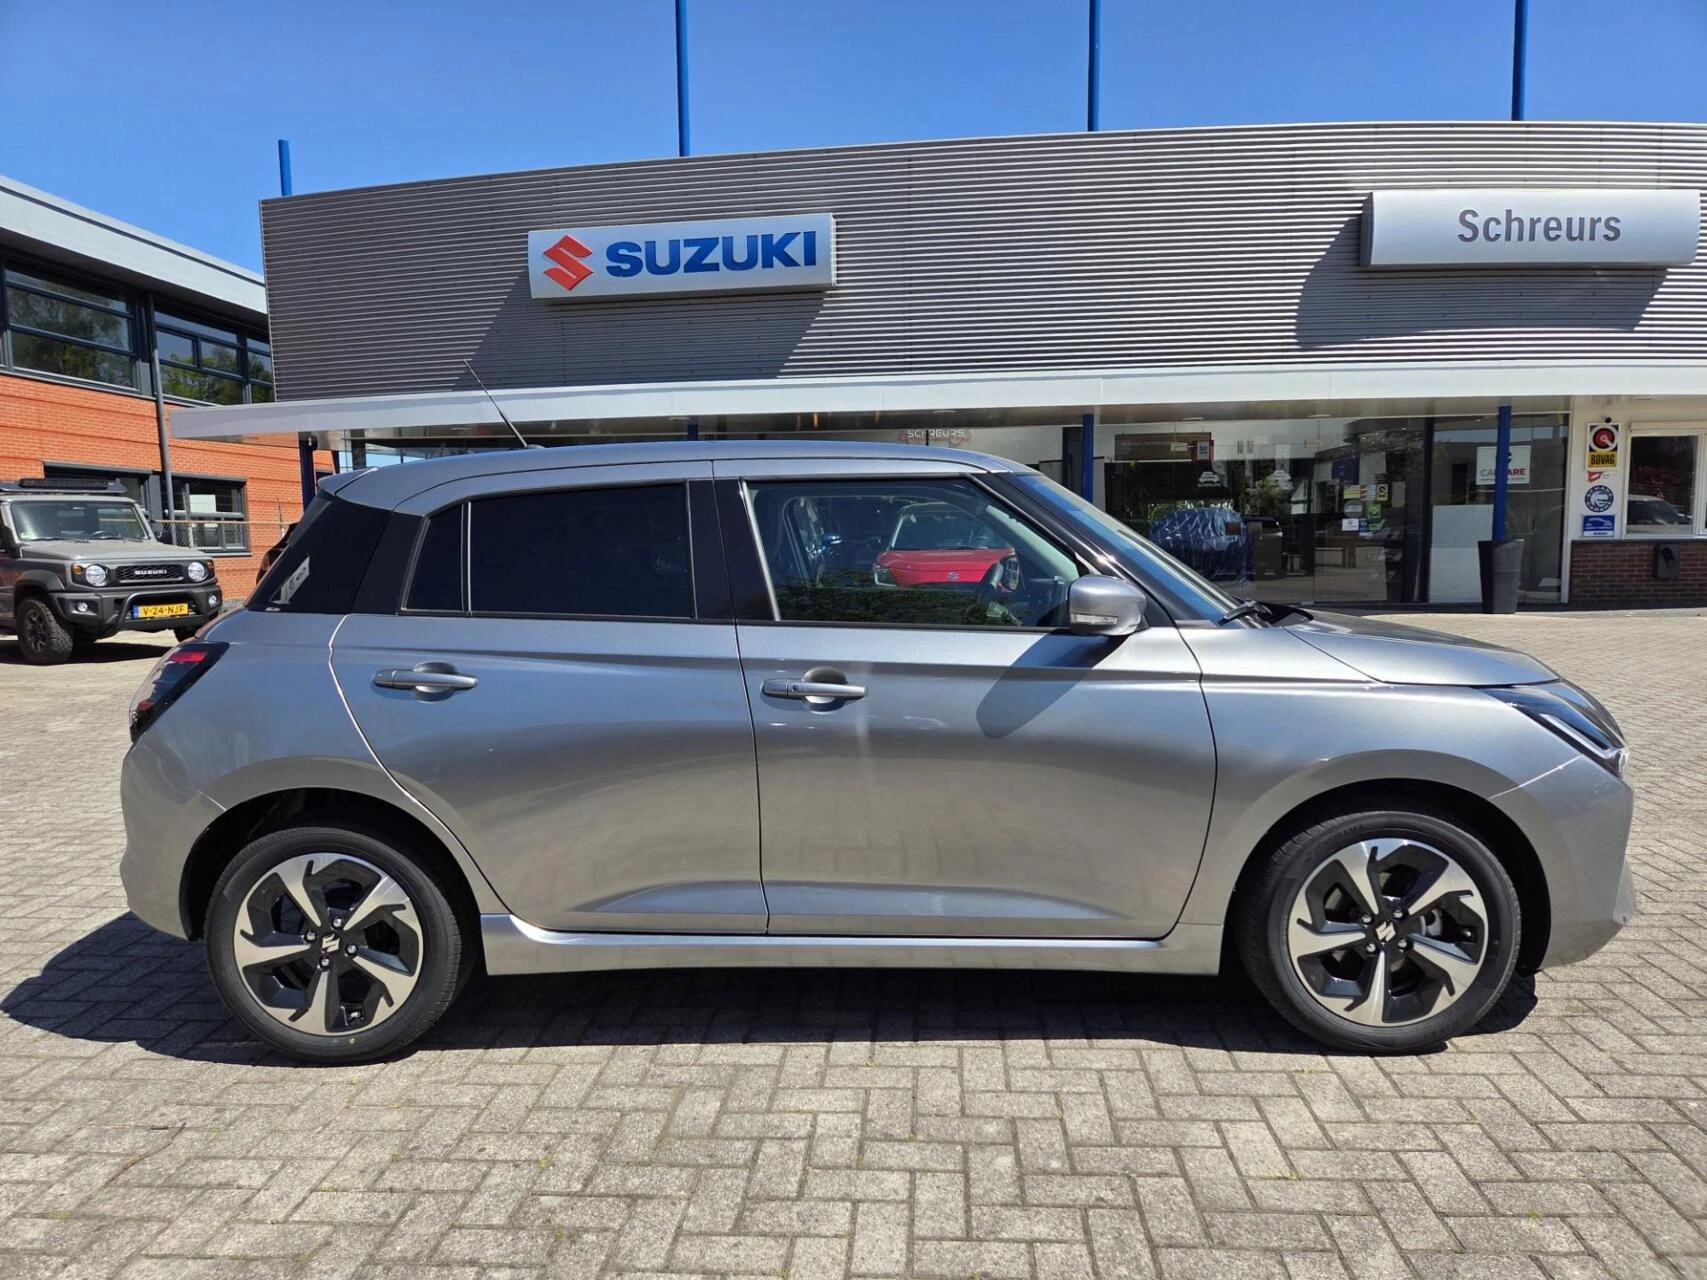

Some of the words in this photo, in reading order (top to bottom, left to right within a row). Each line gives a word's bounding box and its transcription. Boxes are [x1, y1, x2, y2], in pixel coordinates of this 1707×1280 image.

[1457, 208, 1622, 243] Schreurs
[605, 230, 817, 278] SUZUKI
[1590, 453, 1615, 465] BOVAG
